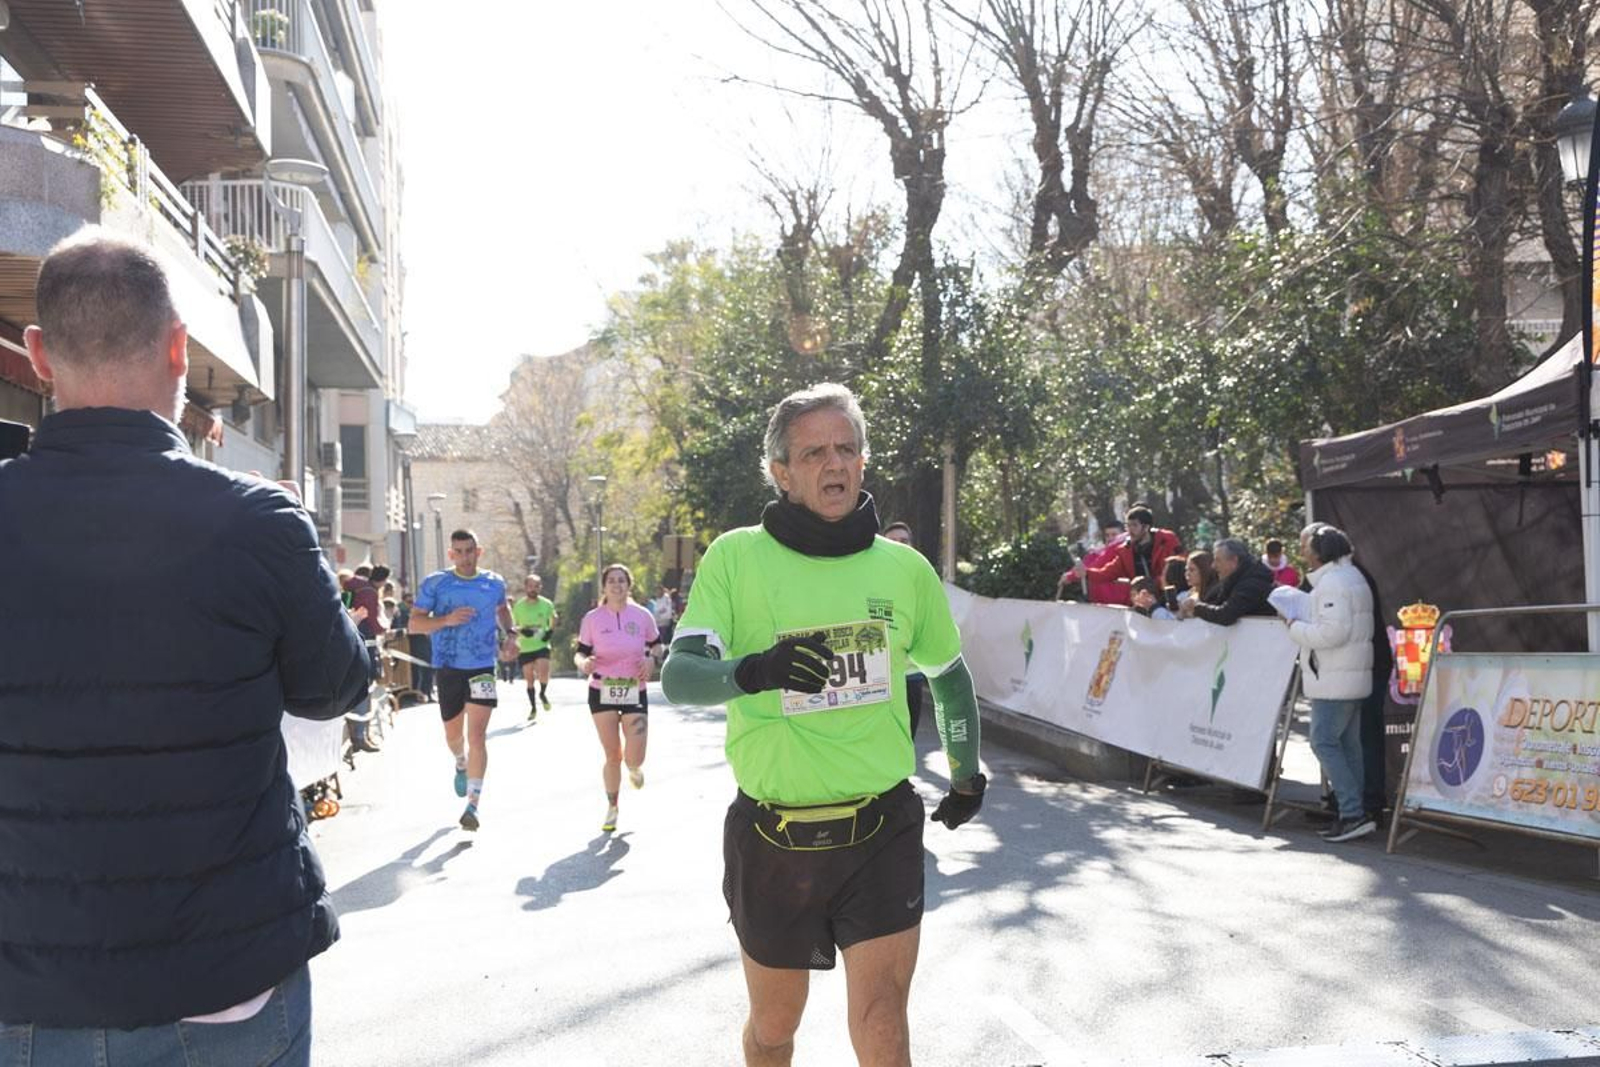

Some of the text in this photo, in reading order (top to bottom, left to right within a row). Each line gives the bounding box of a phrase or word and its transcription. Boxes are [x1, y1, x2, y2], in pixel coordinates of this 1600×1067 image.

[609, 686, 630, 698] 637
[1510, 778, 1549, 805] 623
[1553, 781, 1579, 810] 01
